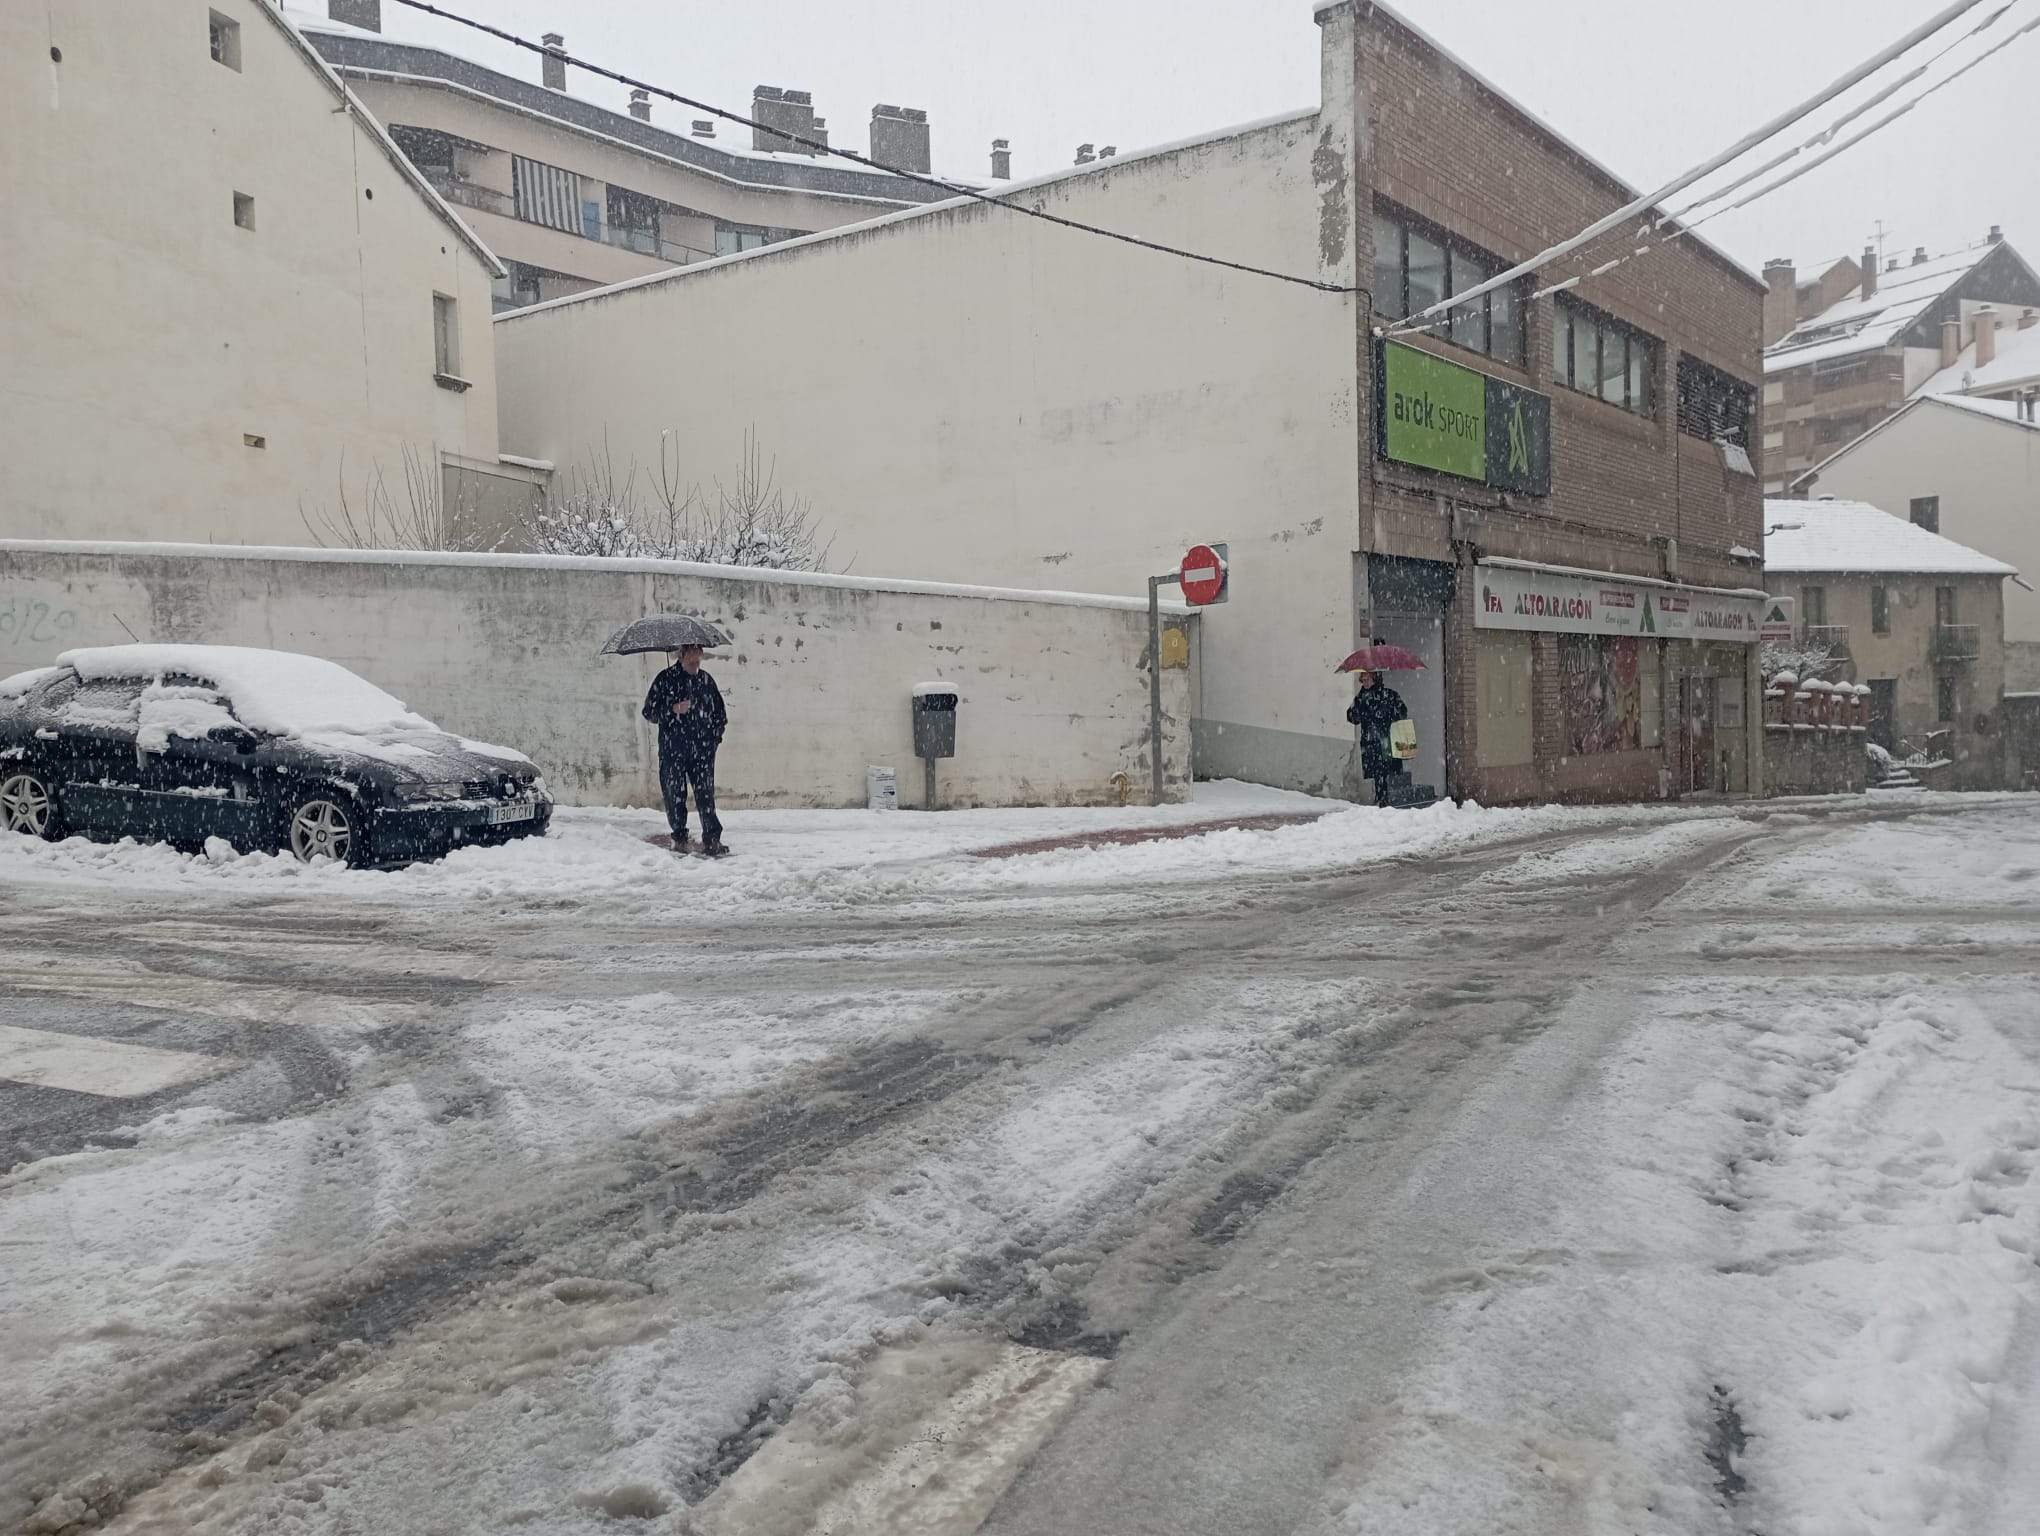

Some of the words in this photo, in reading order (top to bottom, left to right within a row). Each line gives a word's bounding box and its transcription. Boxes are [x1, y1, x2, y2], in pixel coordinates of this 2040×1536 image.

[1394, 391, 1434, 430] arok
[1439, 406, 1480, 441] SPORT
[1514, 592, 1592, 620] ALTOARAGÓN
